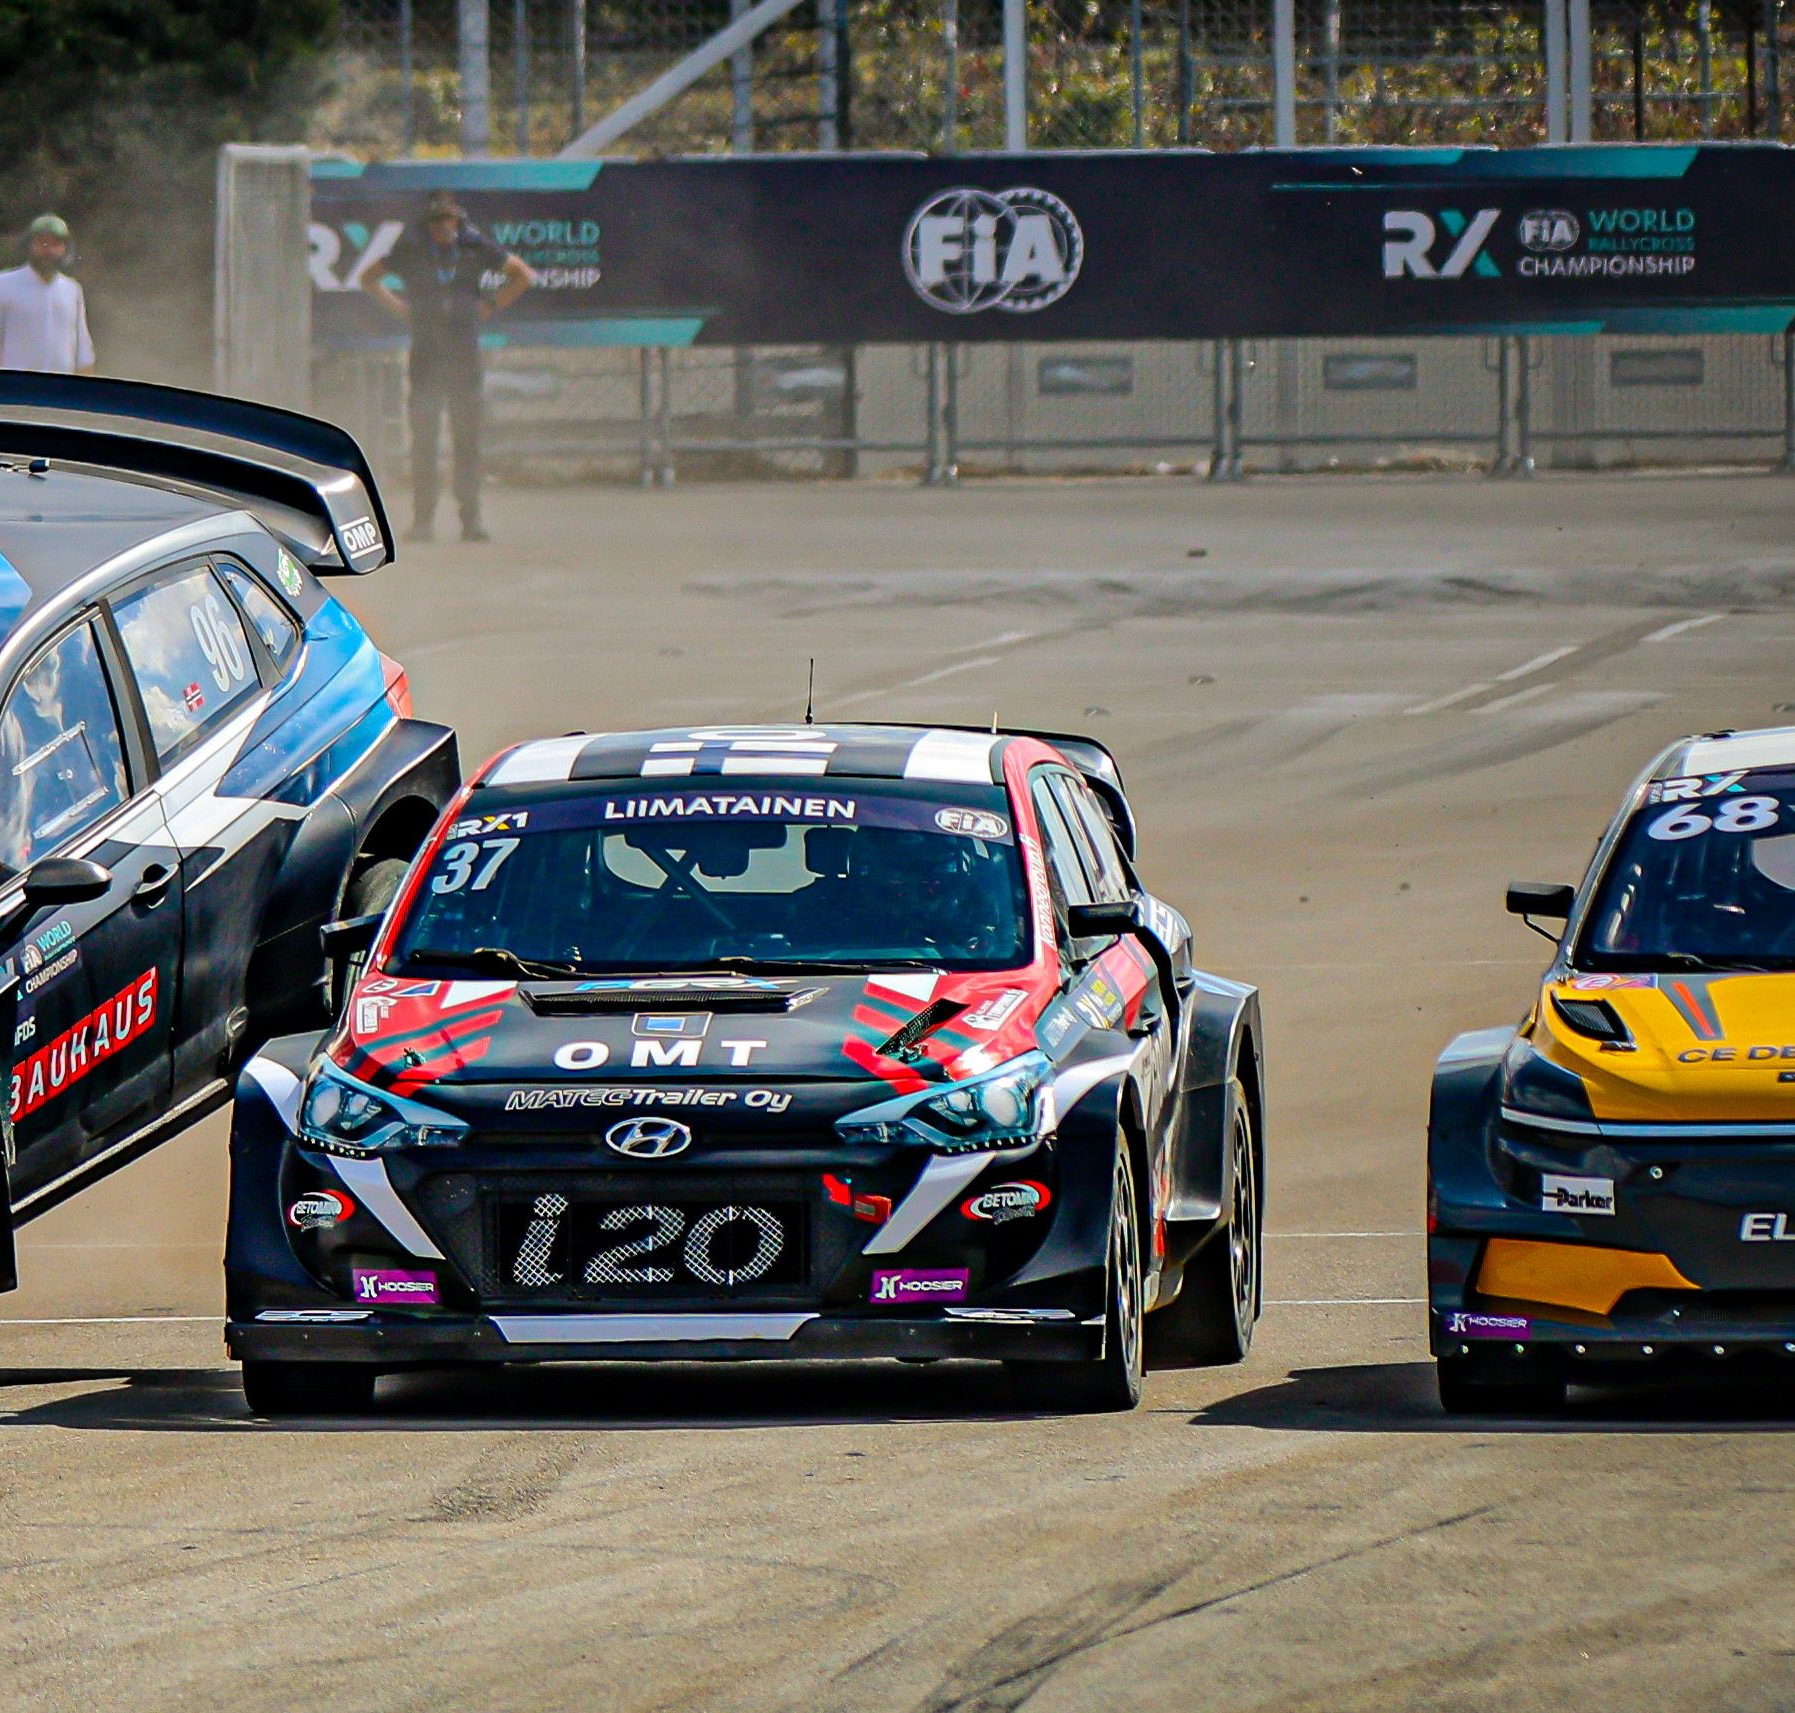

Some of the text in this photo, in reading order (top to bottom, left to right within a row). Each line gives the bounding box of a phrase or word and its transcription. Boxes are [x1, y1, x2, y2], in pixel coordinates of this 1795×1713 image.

[1588, 209, 1695, 232] WORLD
[1384, 208, 1502, 279] RX
[1519, 256, 1696, 277] CHAMPIONSHIP
[343, 522, 377, 552] OMP
[190, 593, 244, 693] 96
[605, 796, 857, 819] LIIMATAINEN
[1647, 796, 1780, 841] 68
[431, 838, 521, 894] 37
[37, 920, 72, 951] WORLD
[25, 949, 78, 993] CHAMPIONSHIP
[10, 979, 154, 1115] BAUHAUS
[554, 1040, 767, 1070] OMT
[1677, 1048, 1737, 1063] CE
[744, 1089, 794, 1113] Oy
[1556, 1186, 1613, 1209] Parker
[513, 1193, 785, 1287] i20
